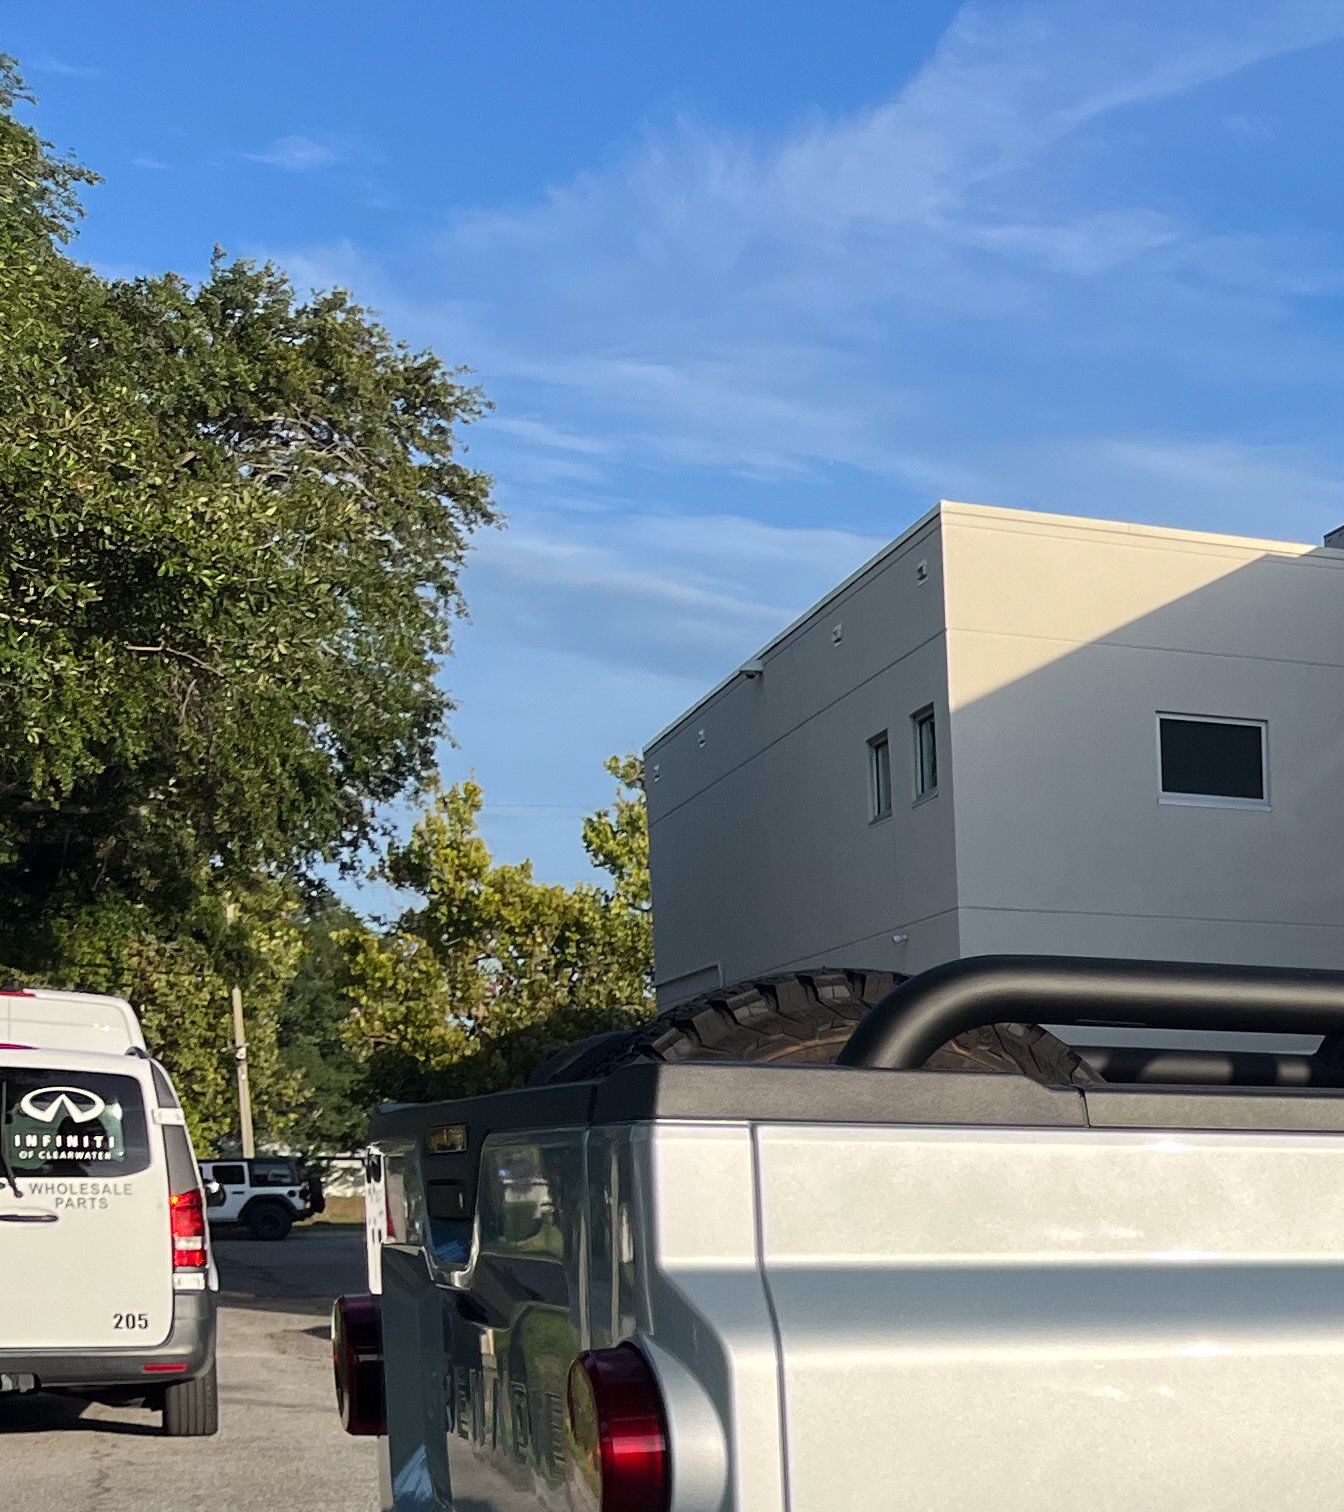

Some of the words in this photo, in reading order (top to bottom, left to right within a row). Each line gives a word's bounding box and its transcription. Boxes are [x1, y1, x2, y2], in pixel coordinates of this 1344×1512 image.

[14, 1134, 115, 1149] INFINITI
[18, 1150, 35, 1160] OF
[38, 1150, 112, 1160] CLEARWATER
[28, 1183, 133, 1196] WHOLESALE
[55, 1197, 108, 1210] PARTS
[113, 1313, 148, 1329] 205
